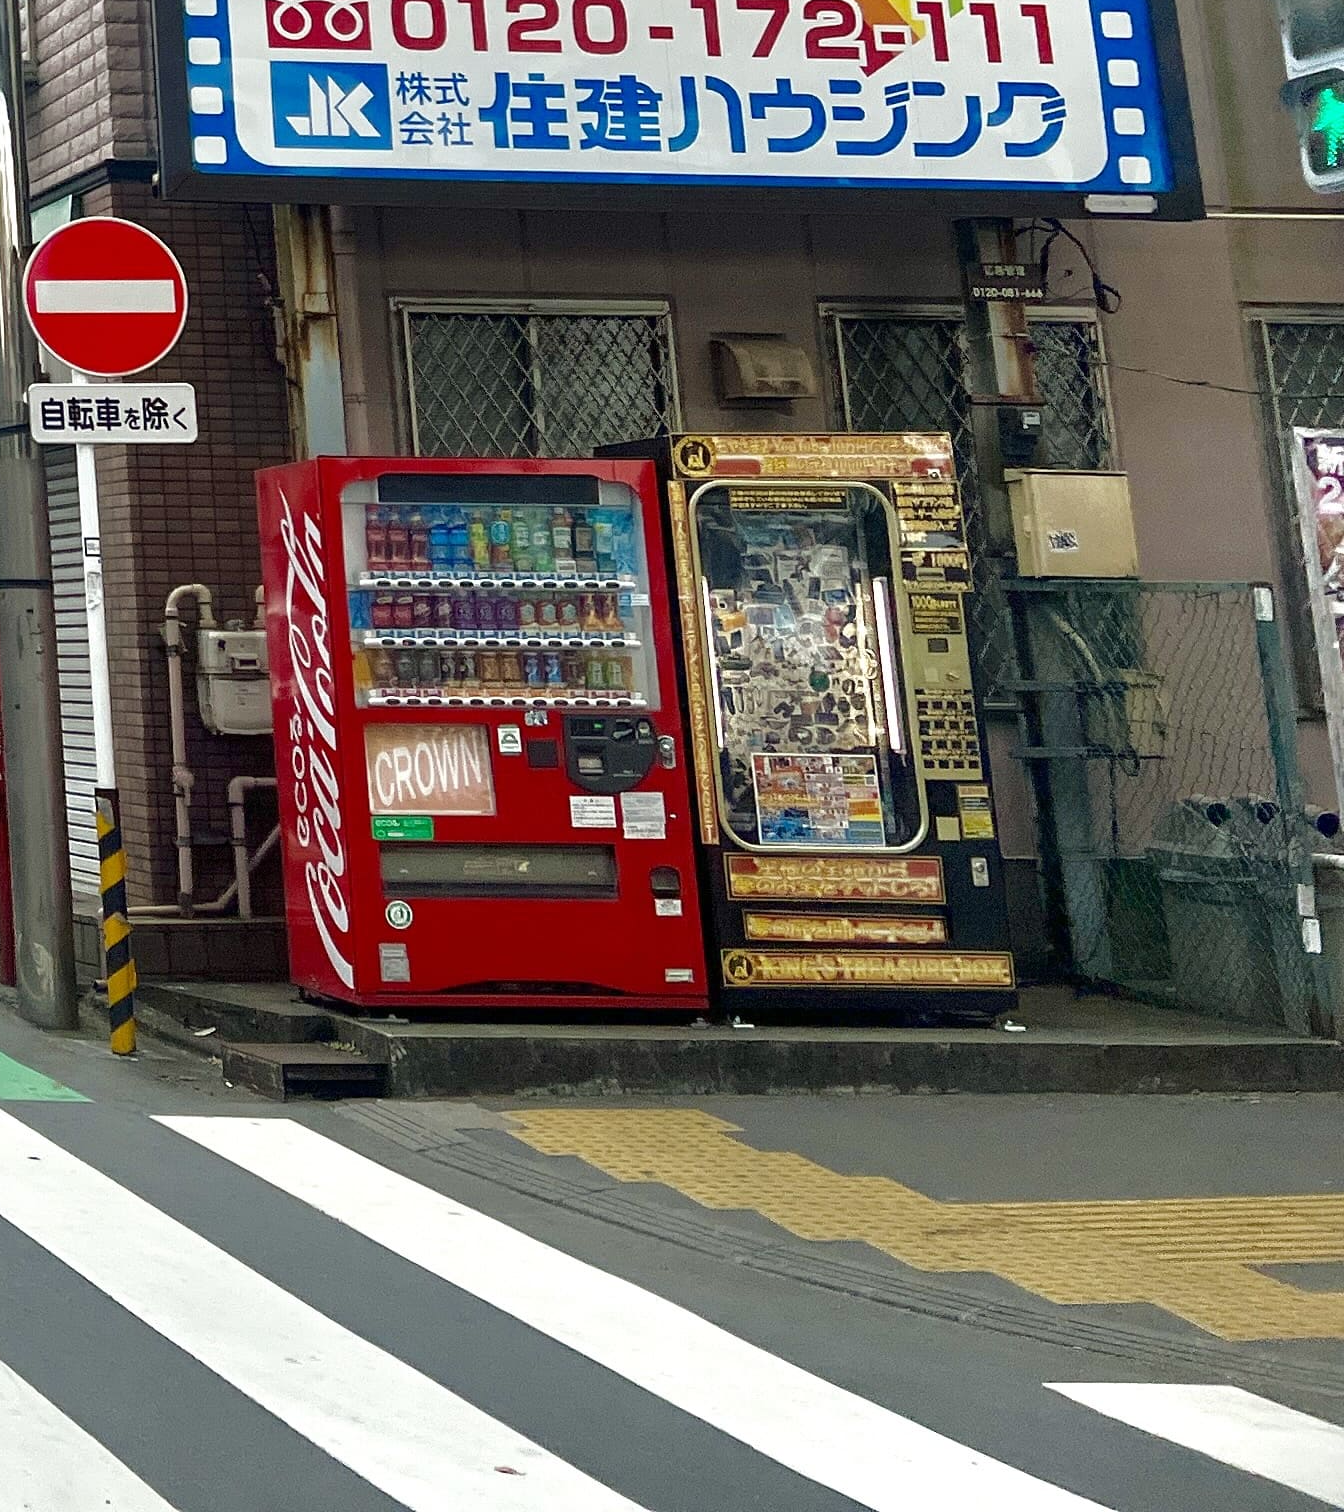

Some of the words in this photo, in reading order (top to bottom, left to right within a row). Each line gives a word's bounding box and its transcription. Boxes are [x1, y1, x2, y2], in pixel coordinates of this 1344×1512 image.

[395, 72, 470, 107] 株式
[398, 110, 473, 147] 会社
[480, 71, 1067, 156] 住建ハウジング
[41, 397, 189, 431] 自転車を除く
[374, 734, 483, 807] CROWN
